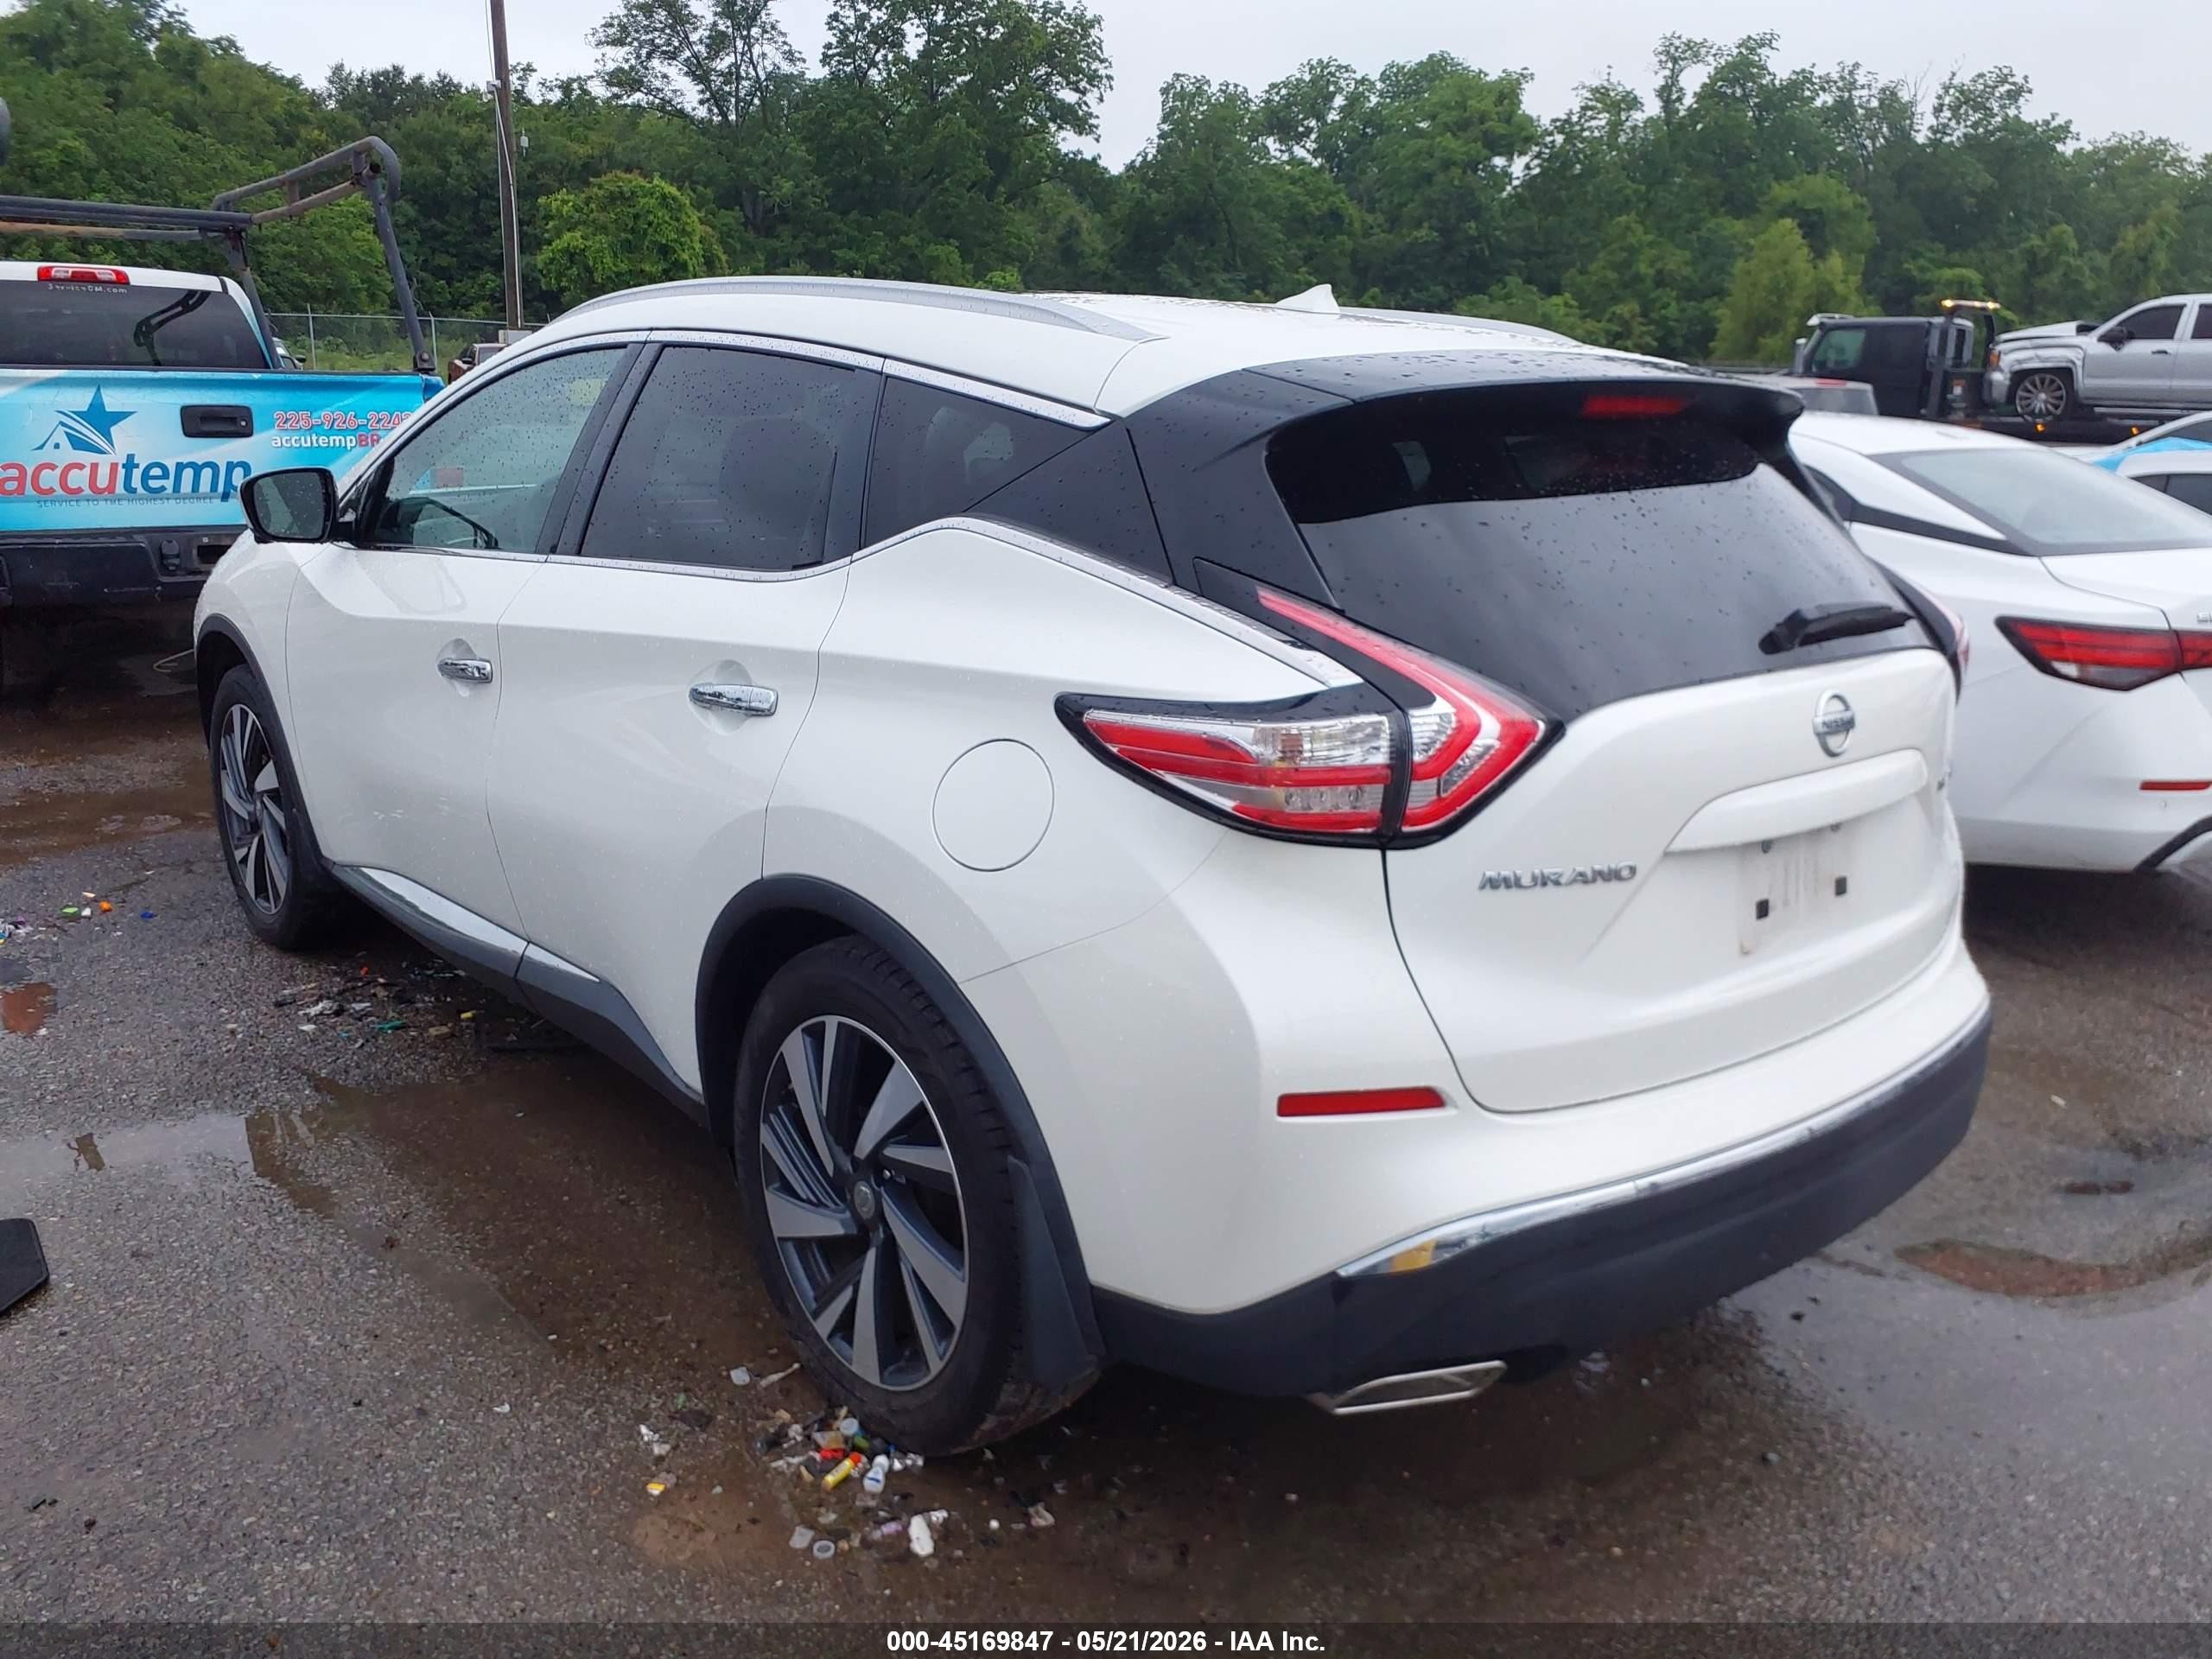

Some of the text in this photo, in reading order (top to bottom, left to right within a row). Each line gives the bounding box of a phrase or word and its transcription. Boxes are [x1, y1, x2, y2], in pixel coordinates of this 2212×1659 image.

[271, 433, 385, 450] accutempBR
[0, 453, 252, 502] accutemp
[36, 499, 81, 508] SERVICE
[128, 497, 171, 505] HIGHEST
[175, 496, 213, 505] DEGREE
[1478, 861, 1637, 890] MURANO
